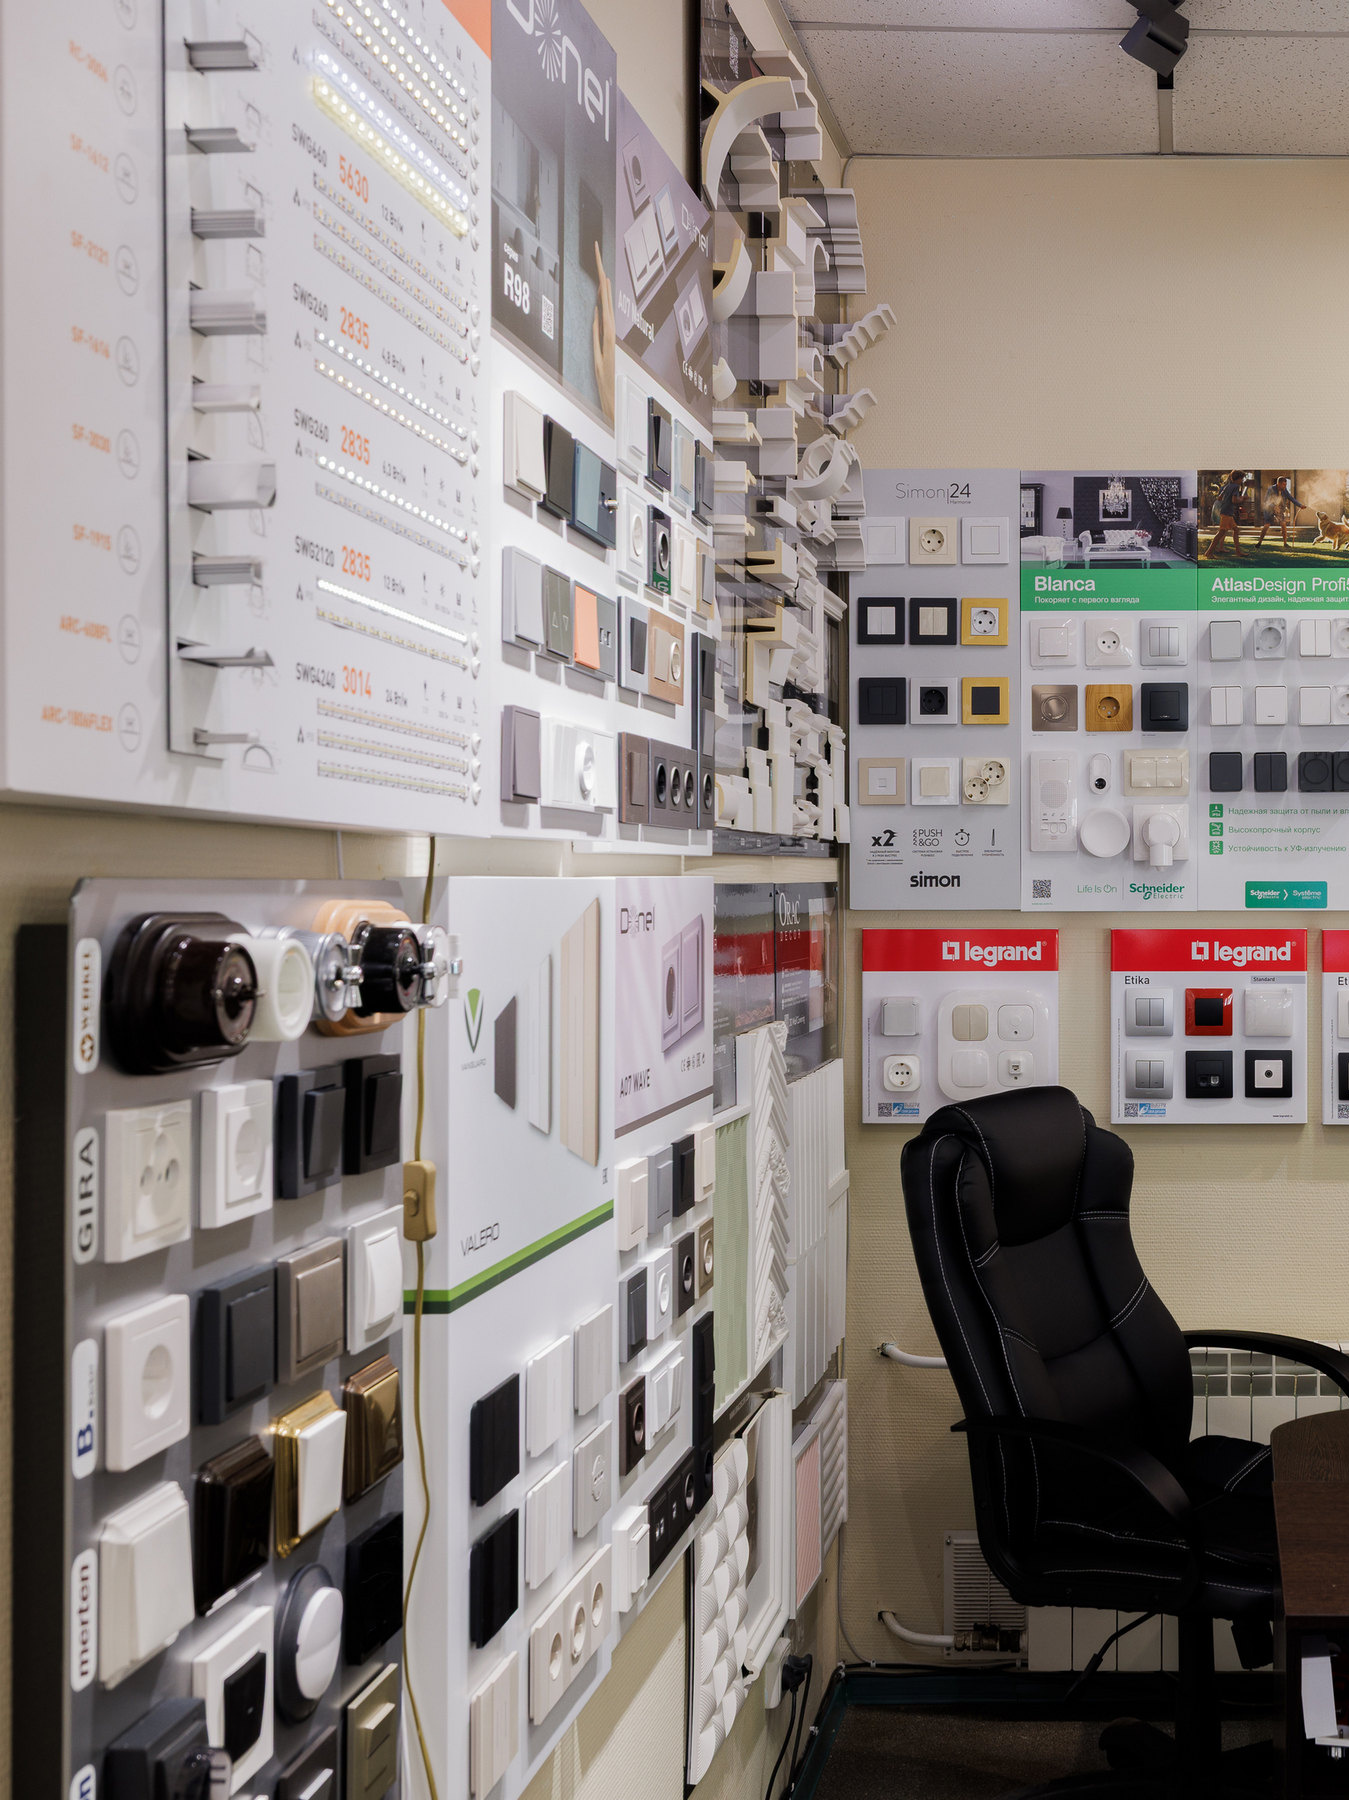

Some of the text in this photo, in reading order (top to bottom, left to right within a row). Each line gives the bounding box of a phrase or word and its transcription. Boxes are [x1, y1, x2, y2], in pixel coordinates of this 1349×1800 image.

[338, 154, 369, 203] 5630
[503, 262, 530, 314] R98
[339, 306, 370, 349] 2835
[294, 408, 329, 443] SWG260
[340, 425, 370, 465] 2835
[294, 535, 335, 567] SWG2120
[341, 545, 371, 582] 2835
[1034, 576, 1096, 592] Blanca
[1211, 577, 1306, 595] AtlasDesign
[342, 665, 371, 698] 3014
[918, 829, 943, 838] PUSH
[918, 838, 940, 847] &GO
[1228, 826, 1292, 834] Высокопрочный
[1228, 844, 1282, 852] Устойчивость
[1290, 845, 1347, 853] УФ-излучению
[910, 870, 960, 888] simon
[1077, 884, 1117, 894] Life Is On
[1129, 883, 1185, 894] Schneider
[1250, 889, 1280, 898] Schneider
[964, 941, 1042, 967] legrand
[1213, 941, 1291, 967] legrand
[1124, 976, 1150, 985] Etika
[633, 1068, 650, 1092] WAVE
[79, 1138, 95, 1252] GIRA
[461, 1222, 499, 1256] VALERO
[78, 1564, 91, 1678] merten
